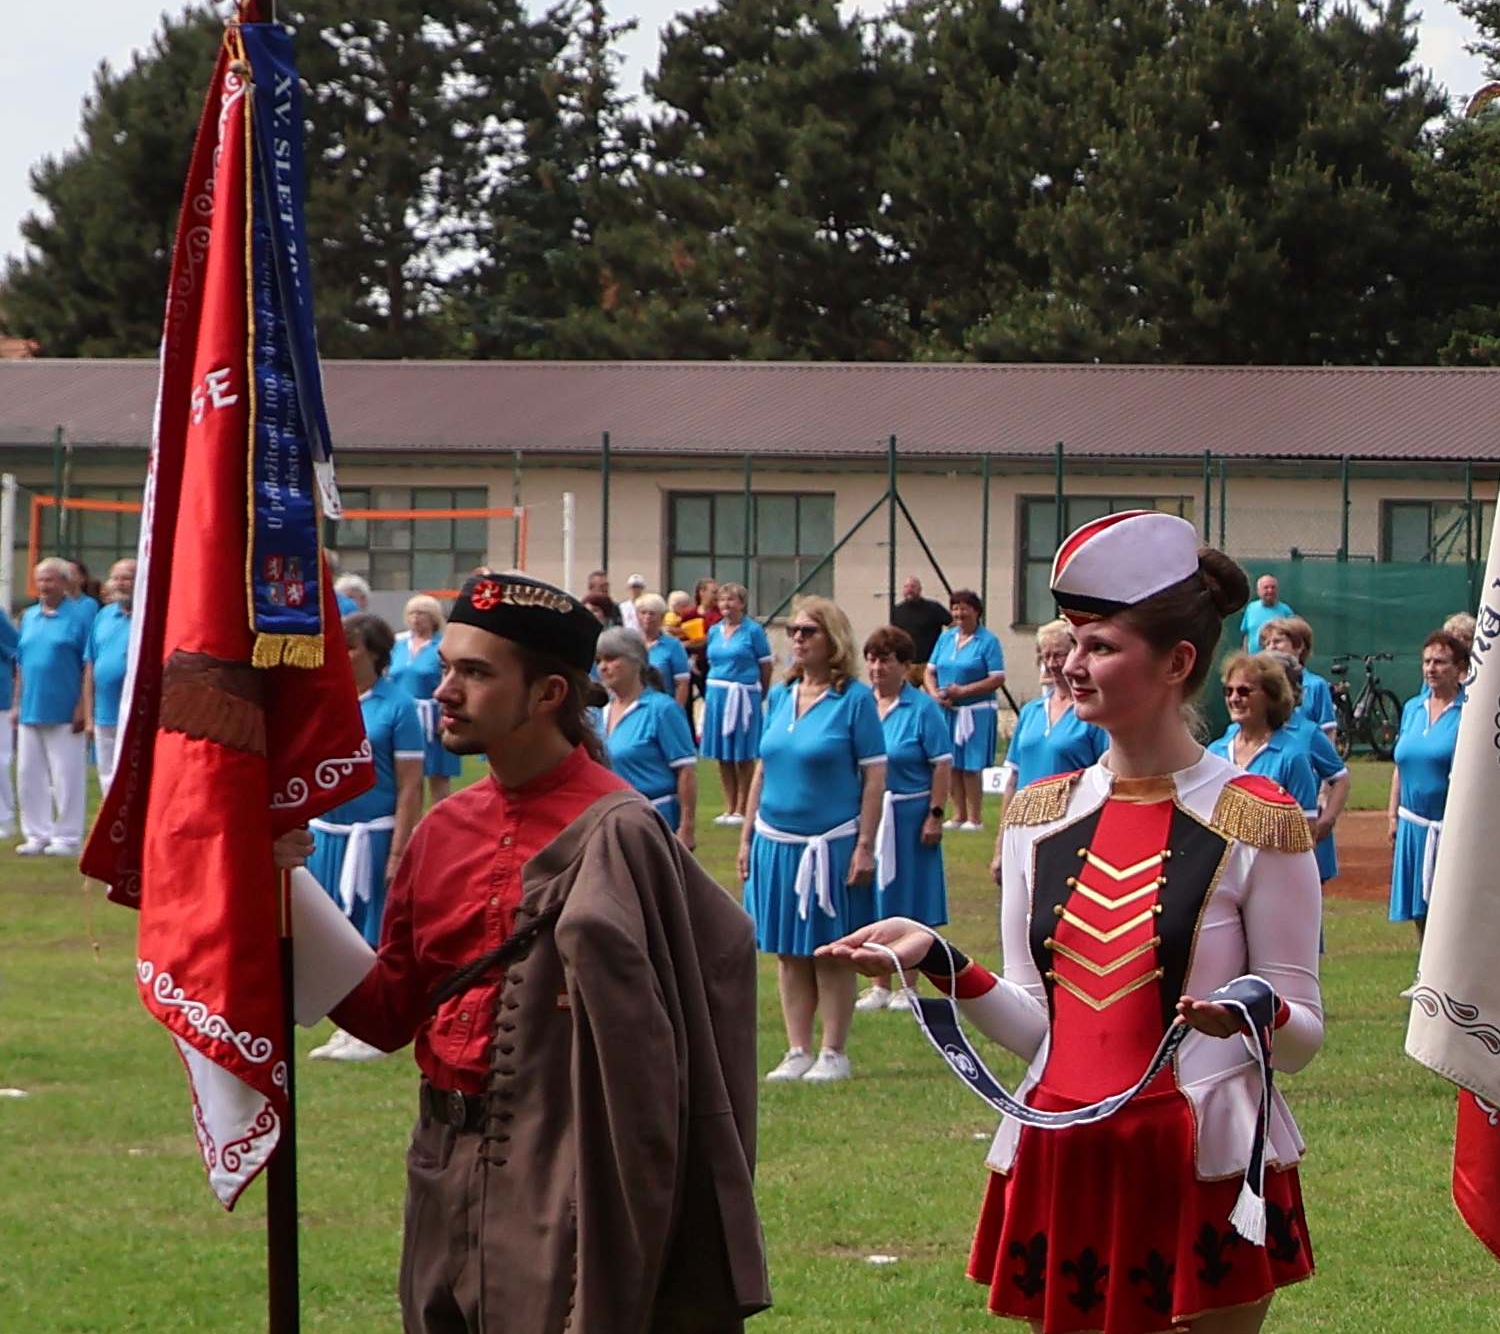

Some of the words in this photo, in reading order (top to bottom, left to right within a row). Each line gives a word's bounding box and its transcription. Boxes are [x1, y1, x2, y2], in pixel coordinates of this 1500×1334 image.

[273, 73, 291, 128] XV.
[274, 137, 295, 231] SLET
[264, 373, 278, 409] 100.
[285, 445, 300, 497] město
